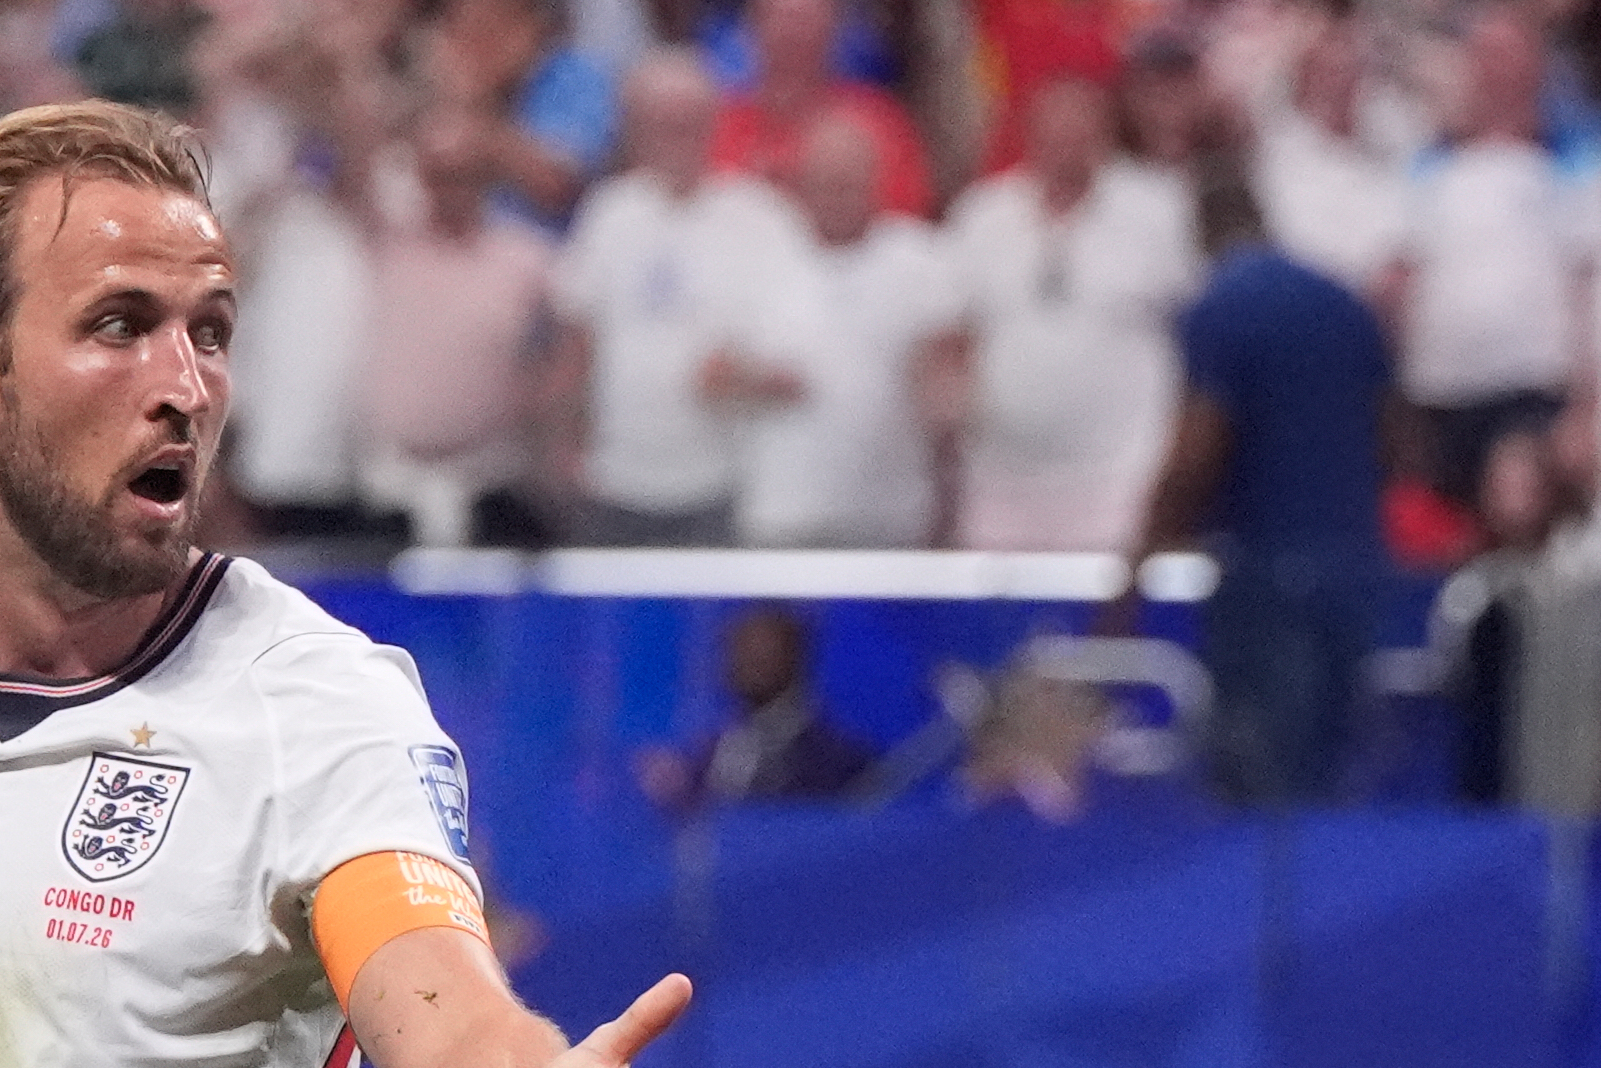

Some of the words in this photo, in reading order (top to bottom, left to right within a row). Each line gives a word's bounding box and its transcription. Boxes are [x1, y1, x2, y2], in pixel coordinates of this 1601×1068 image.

[44, 887, 105, 914] CONGO
[109, 896, 135, 921] DR
[402, 885, 447, 906] the
[46, 918, 113, 948] 01.07.26
